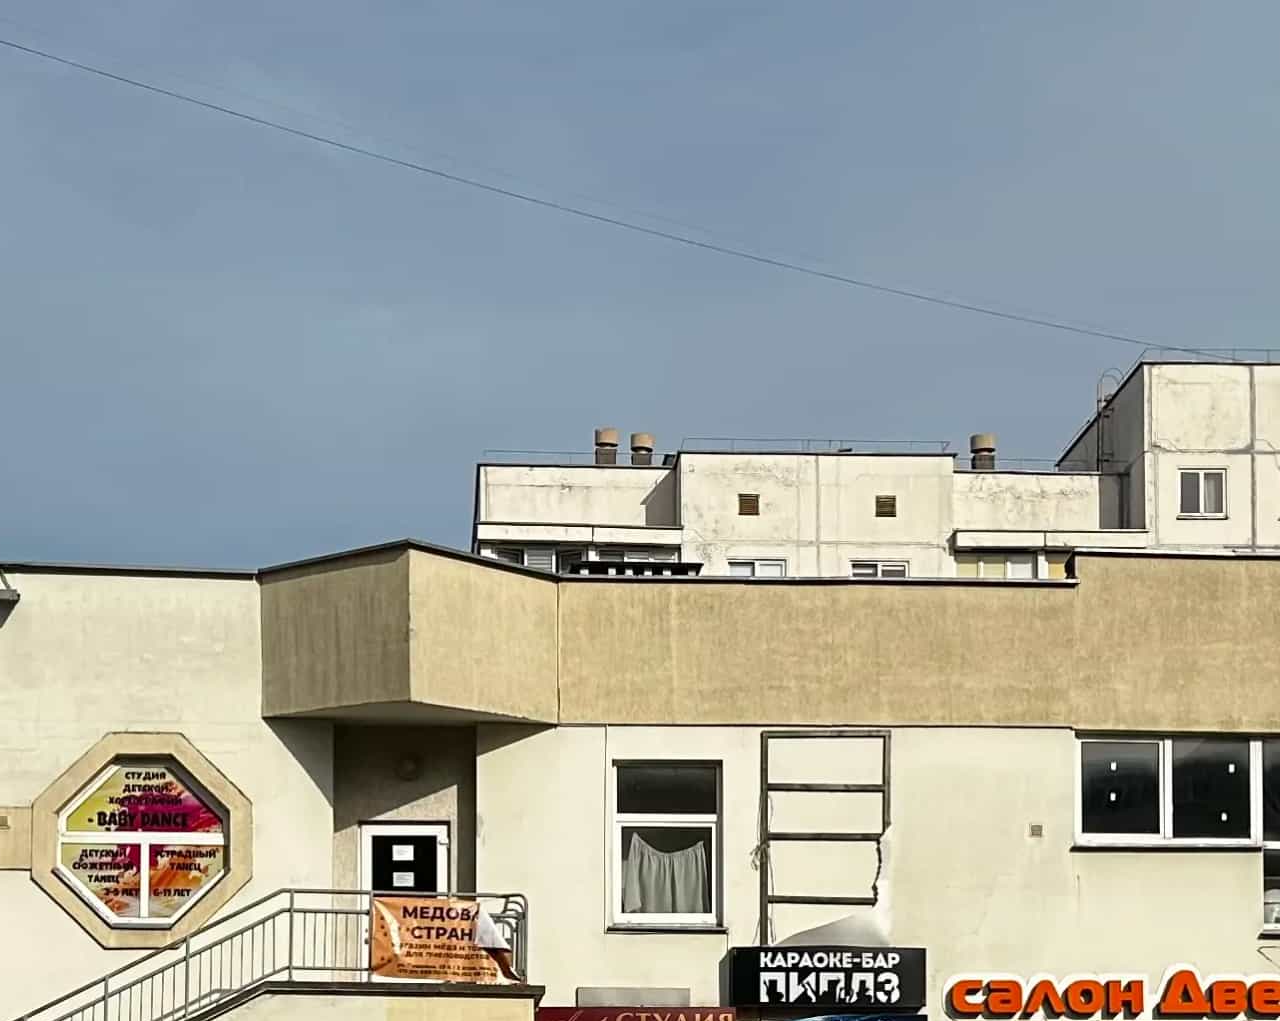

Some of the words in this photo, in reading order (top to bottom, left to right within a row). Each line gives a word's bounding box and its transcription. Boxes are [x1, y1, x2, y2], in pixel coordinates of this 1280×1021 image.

[124, 771, 167, 781] СТУДИЯ
[96, 811, 138, 827] BABY
[173, 887, 192, 897] ЛЕТ
[411, 926, 473, 941] СТРАН
[759, 951, 900, 969] КАРАОКЕ-БАР
[950, 978, 1145, 1016] салон
